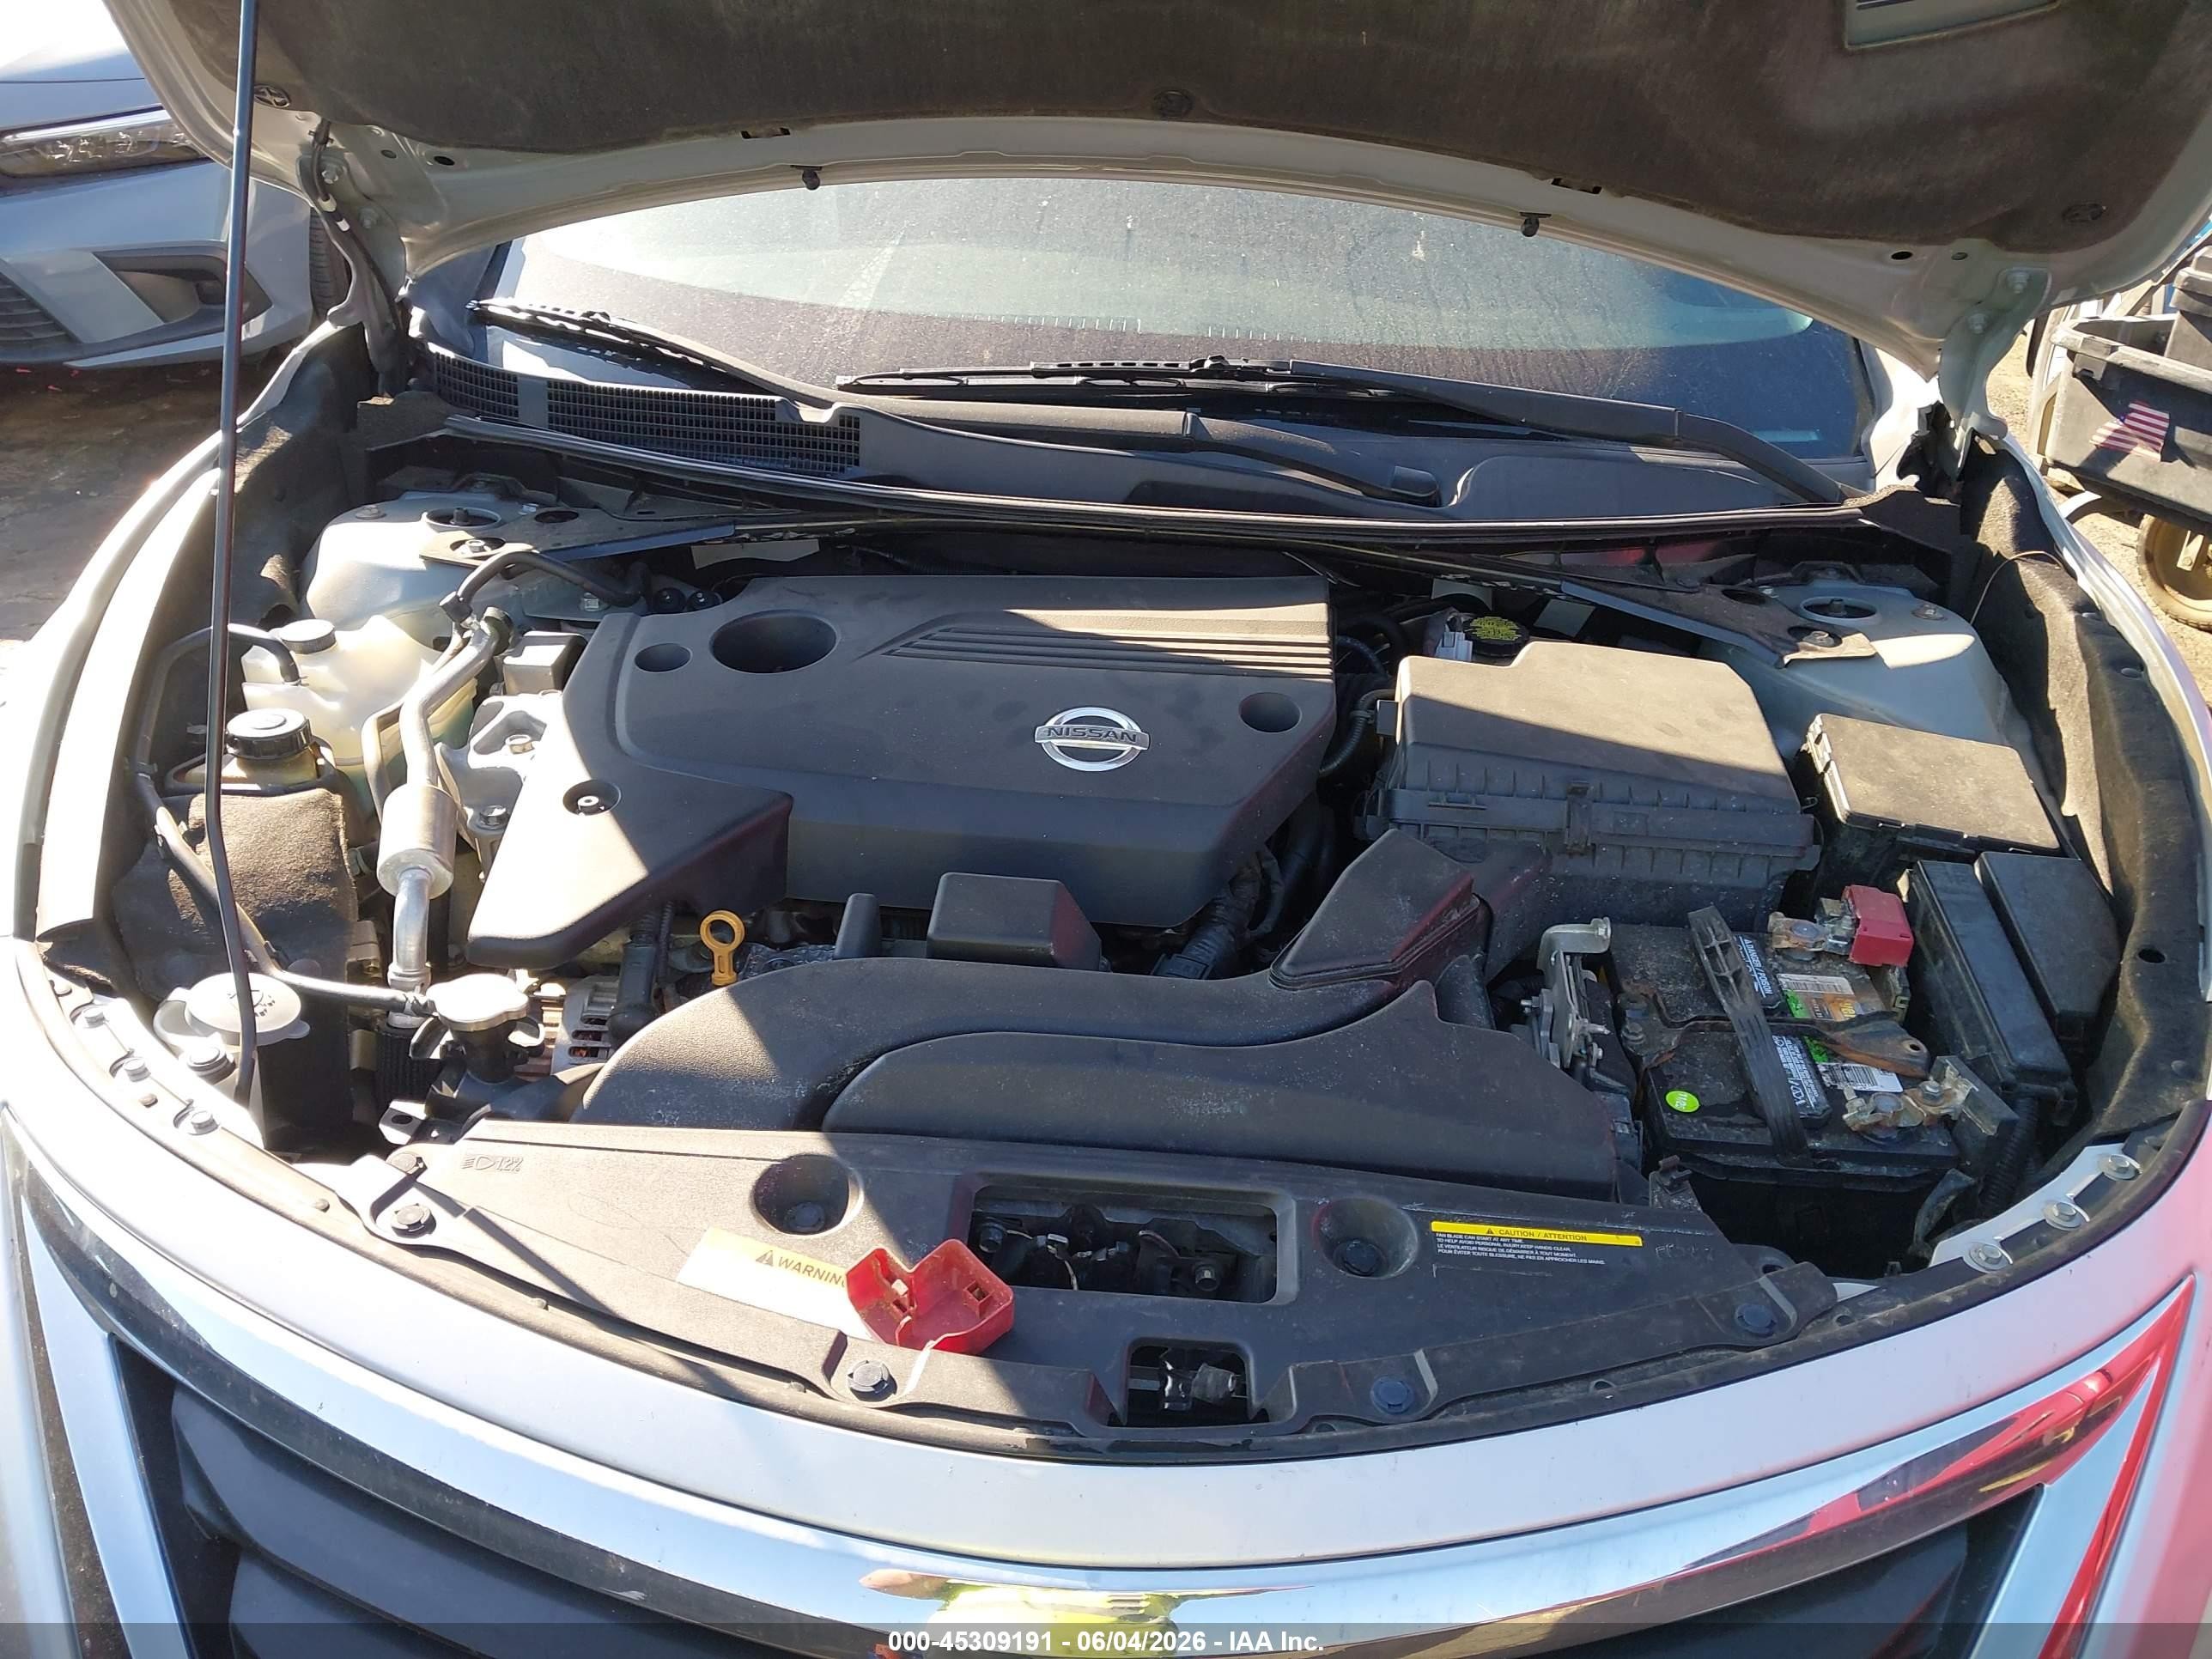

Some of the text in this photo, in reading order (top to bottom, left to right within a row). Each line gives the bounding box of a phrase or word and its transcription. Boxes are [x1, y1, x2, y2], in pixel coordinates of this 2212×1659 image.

[1048, 727, 1137, 743] NISSAN
[1747, 944, 1761, 968] DANGER
[1758, 972, 1772, 994] POISON
[1544, 1232, 1588, 1241] ATTENTION
